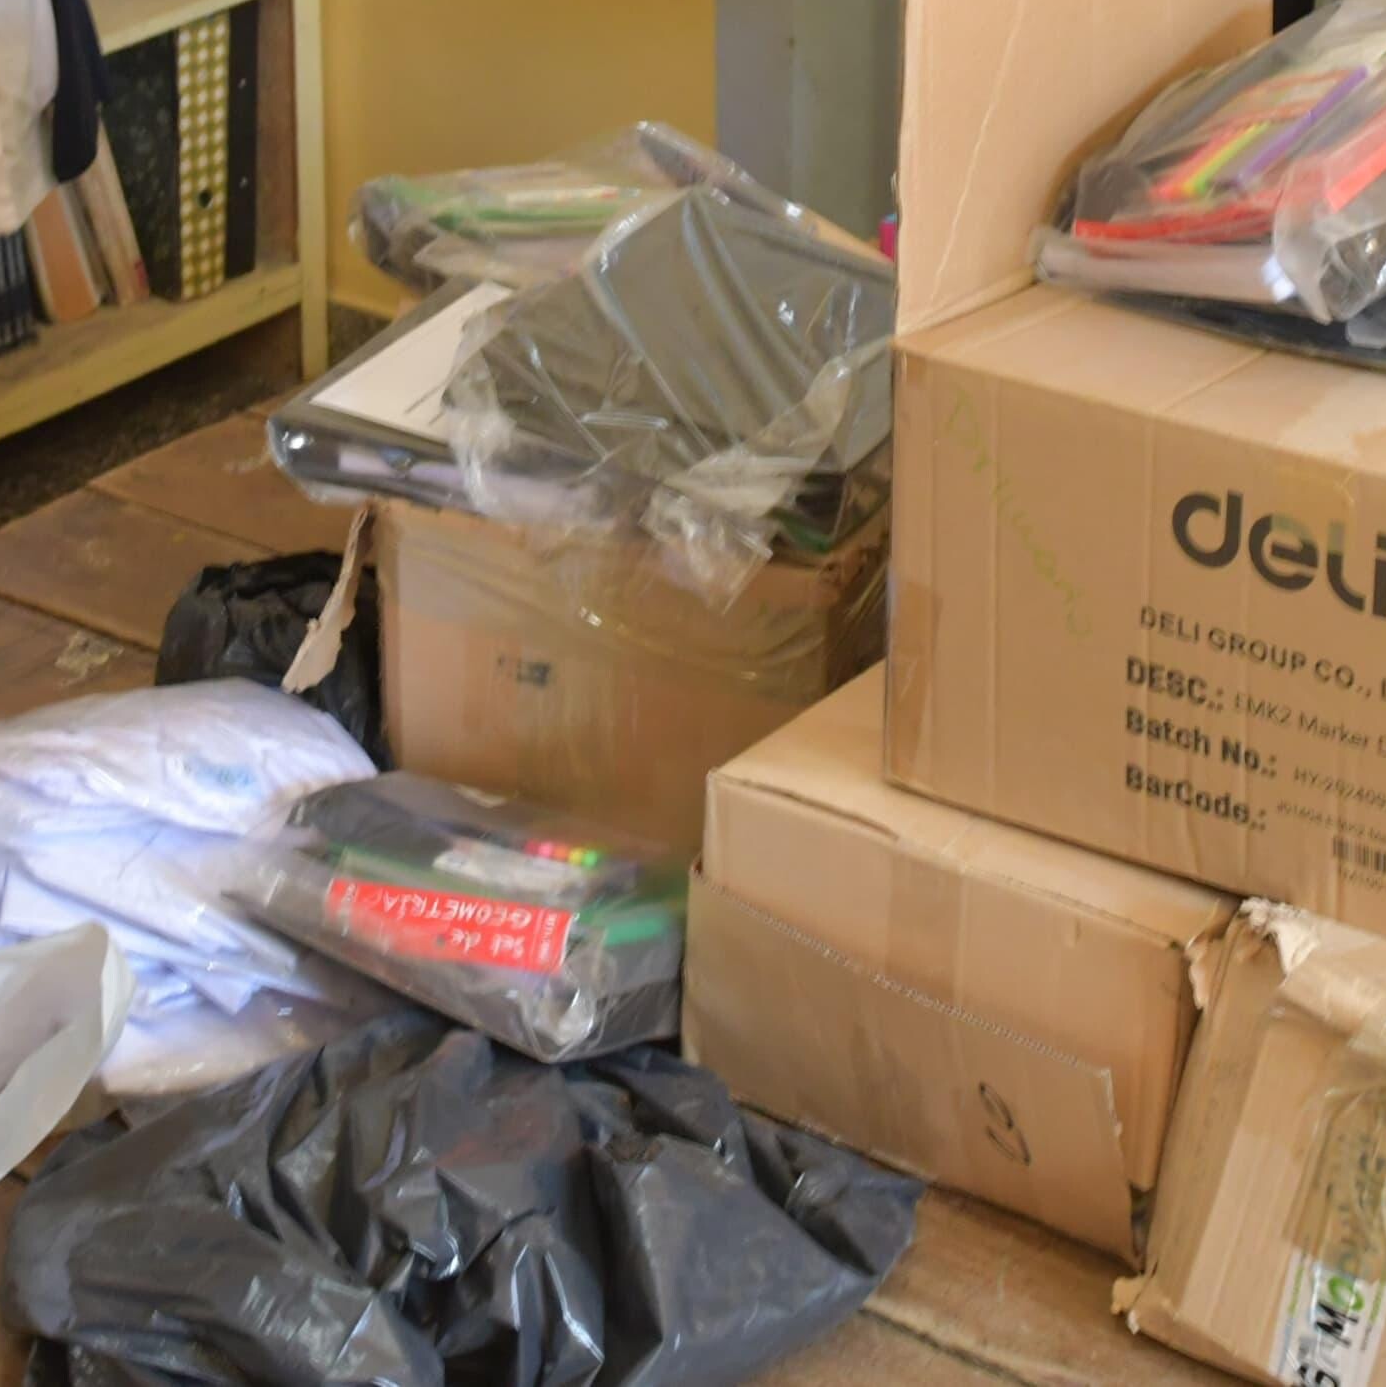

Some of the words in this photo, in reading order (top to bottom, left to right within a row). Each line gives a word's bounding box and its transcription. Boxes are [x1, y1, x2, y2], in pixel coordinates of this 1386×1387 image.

[1139, 604, 1201, 643] DELI
[1208, 626, 1308, 673] GROUP
[1313, 657, 1373, 699] CO.,
[1124, 705, 1211, 758] Batch
[1220, 736, 1278, 780] No.:
[1125, 654, 1225, 712] DESC.:
[1297, 711, 1370, 751] Marker
[1124, 762, 1268, 833] BarCode.:
